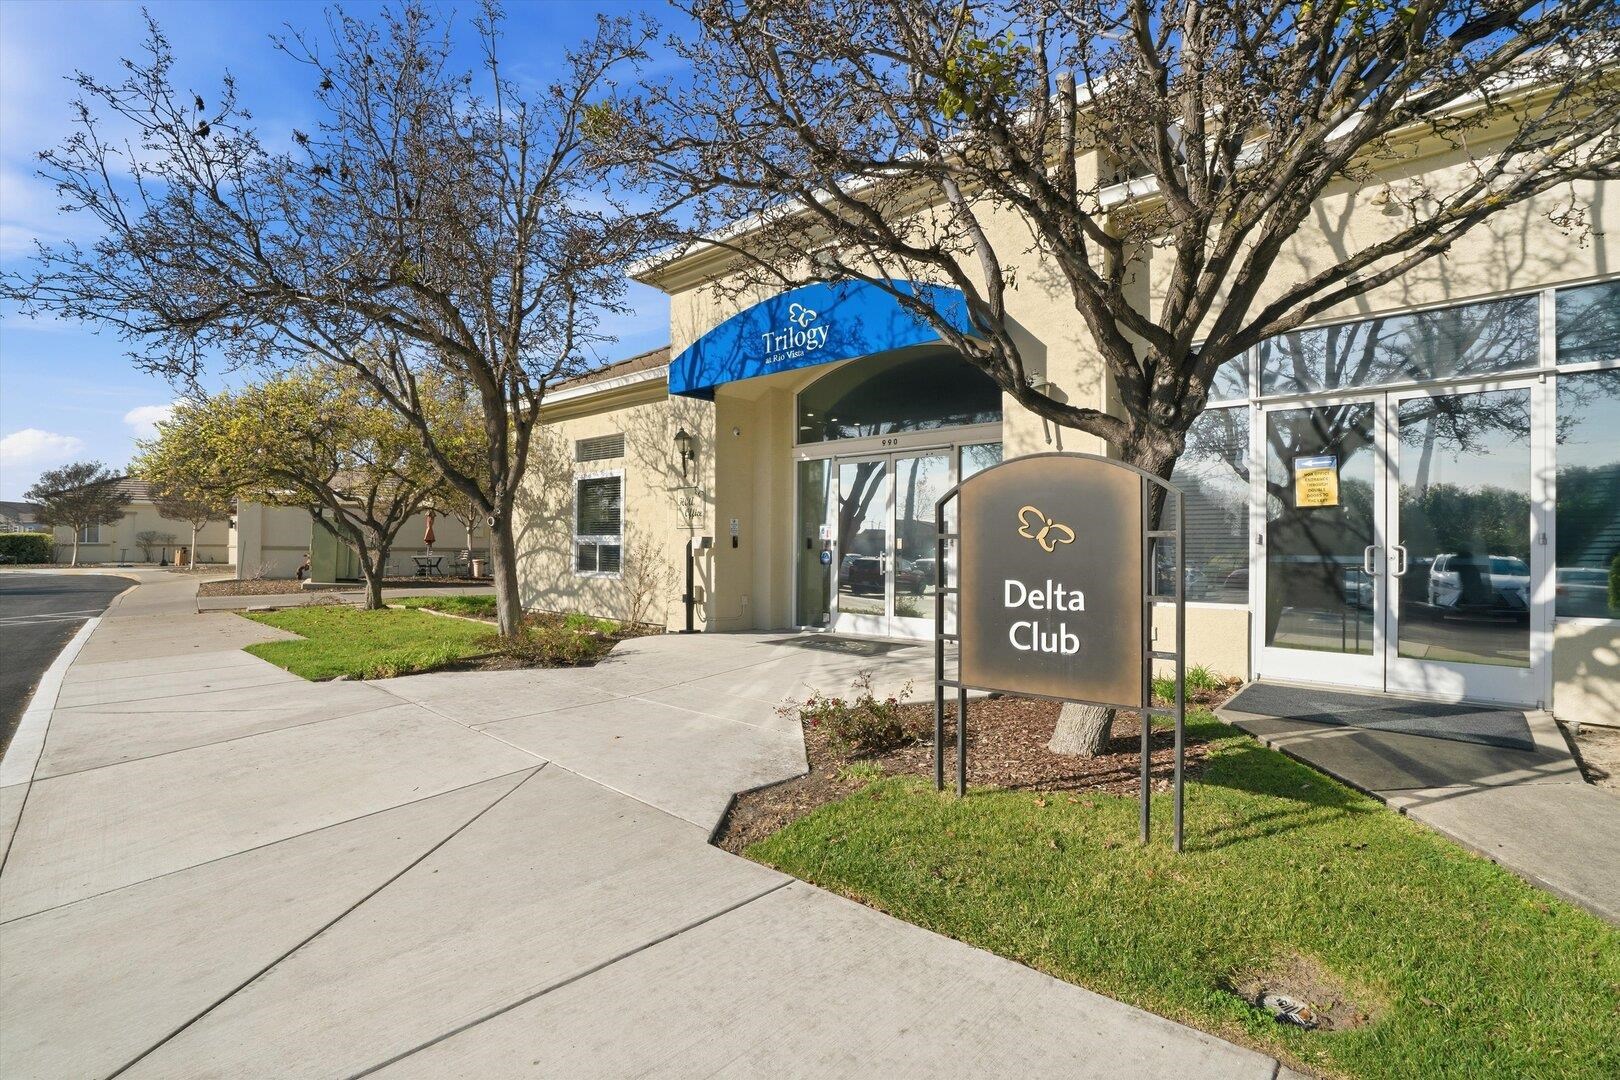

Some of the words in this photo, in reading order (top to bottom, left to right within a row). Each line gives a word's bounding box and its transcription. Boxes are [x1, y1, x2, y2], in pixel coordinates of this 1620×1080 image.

[761, 325, 829, 354] Trilogy
[773, 353, 785, 362] Rio
[786, 350, 805, 359] Vista
[881, 438, 898, 446] 990
[1004, 579, 1086, 611] Delta
[1008, 621, 1080, 654] Club
